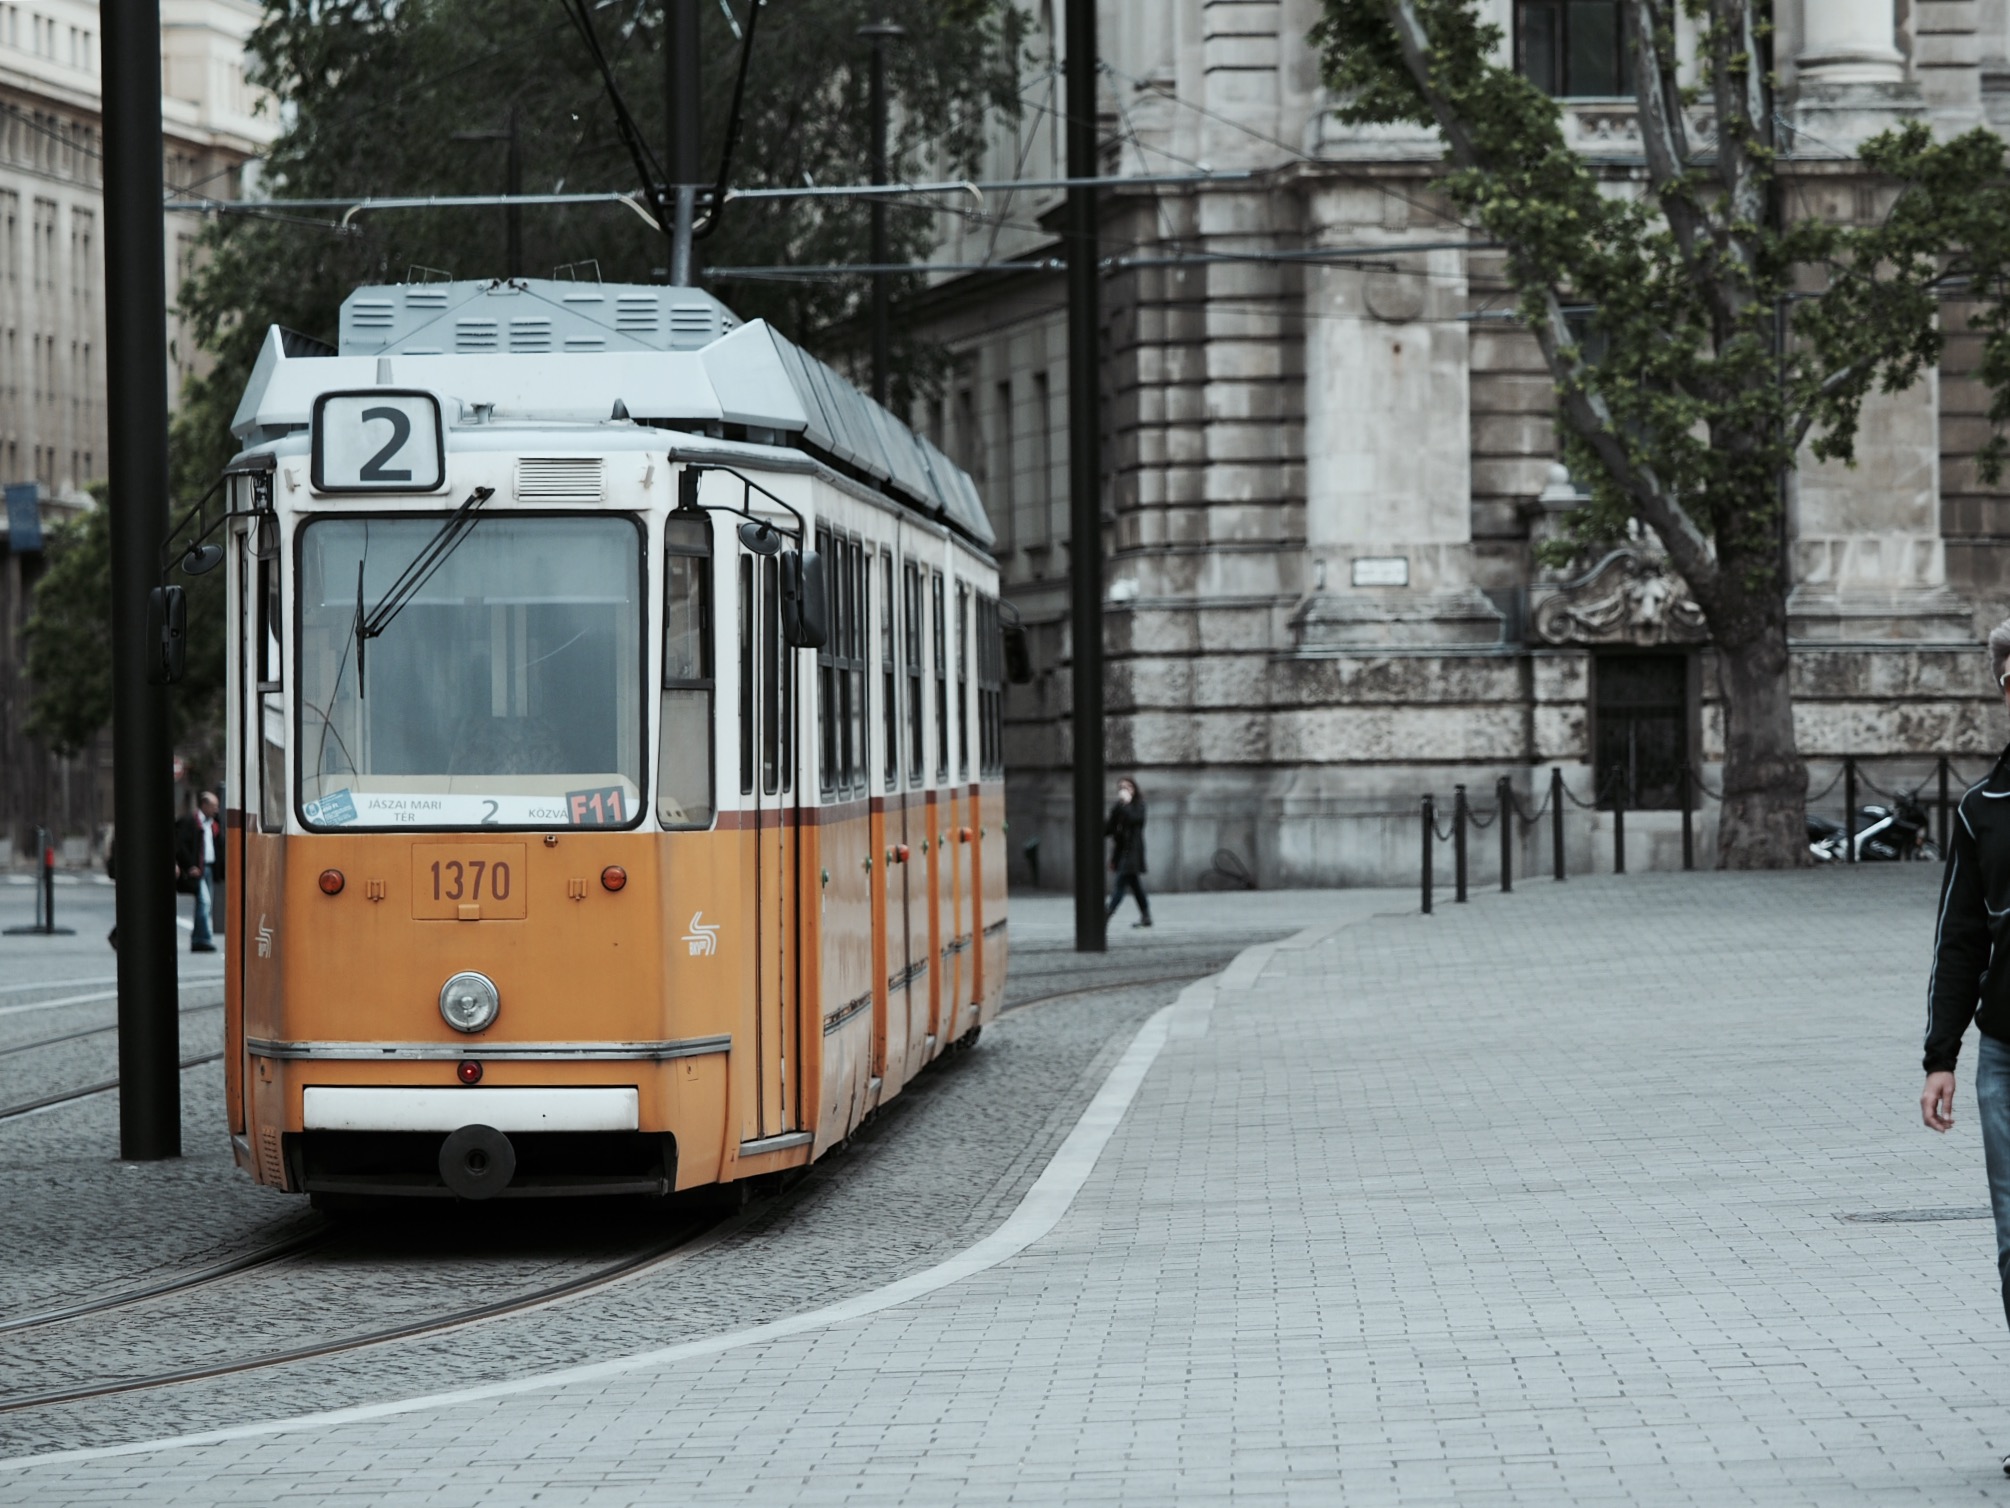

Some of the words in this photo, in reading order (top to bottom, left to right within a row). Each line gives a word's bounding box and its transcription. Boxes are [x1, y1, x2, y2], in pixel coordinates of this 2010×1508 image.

[360, 406, 412, 481] 2
[368, 798, 407, 809] JÁSZAI
[410, 800, 442, 809] MARI
[394, 811, 416, 822] TÉR
[481, 799, 499, 824] 2
[570, 791, 622, 824] F11
[431, 860, 510, 901] 1370
